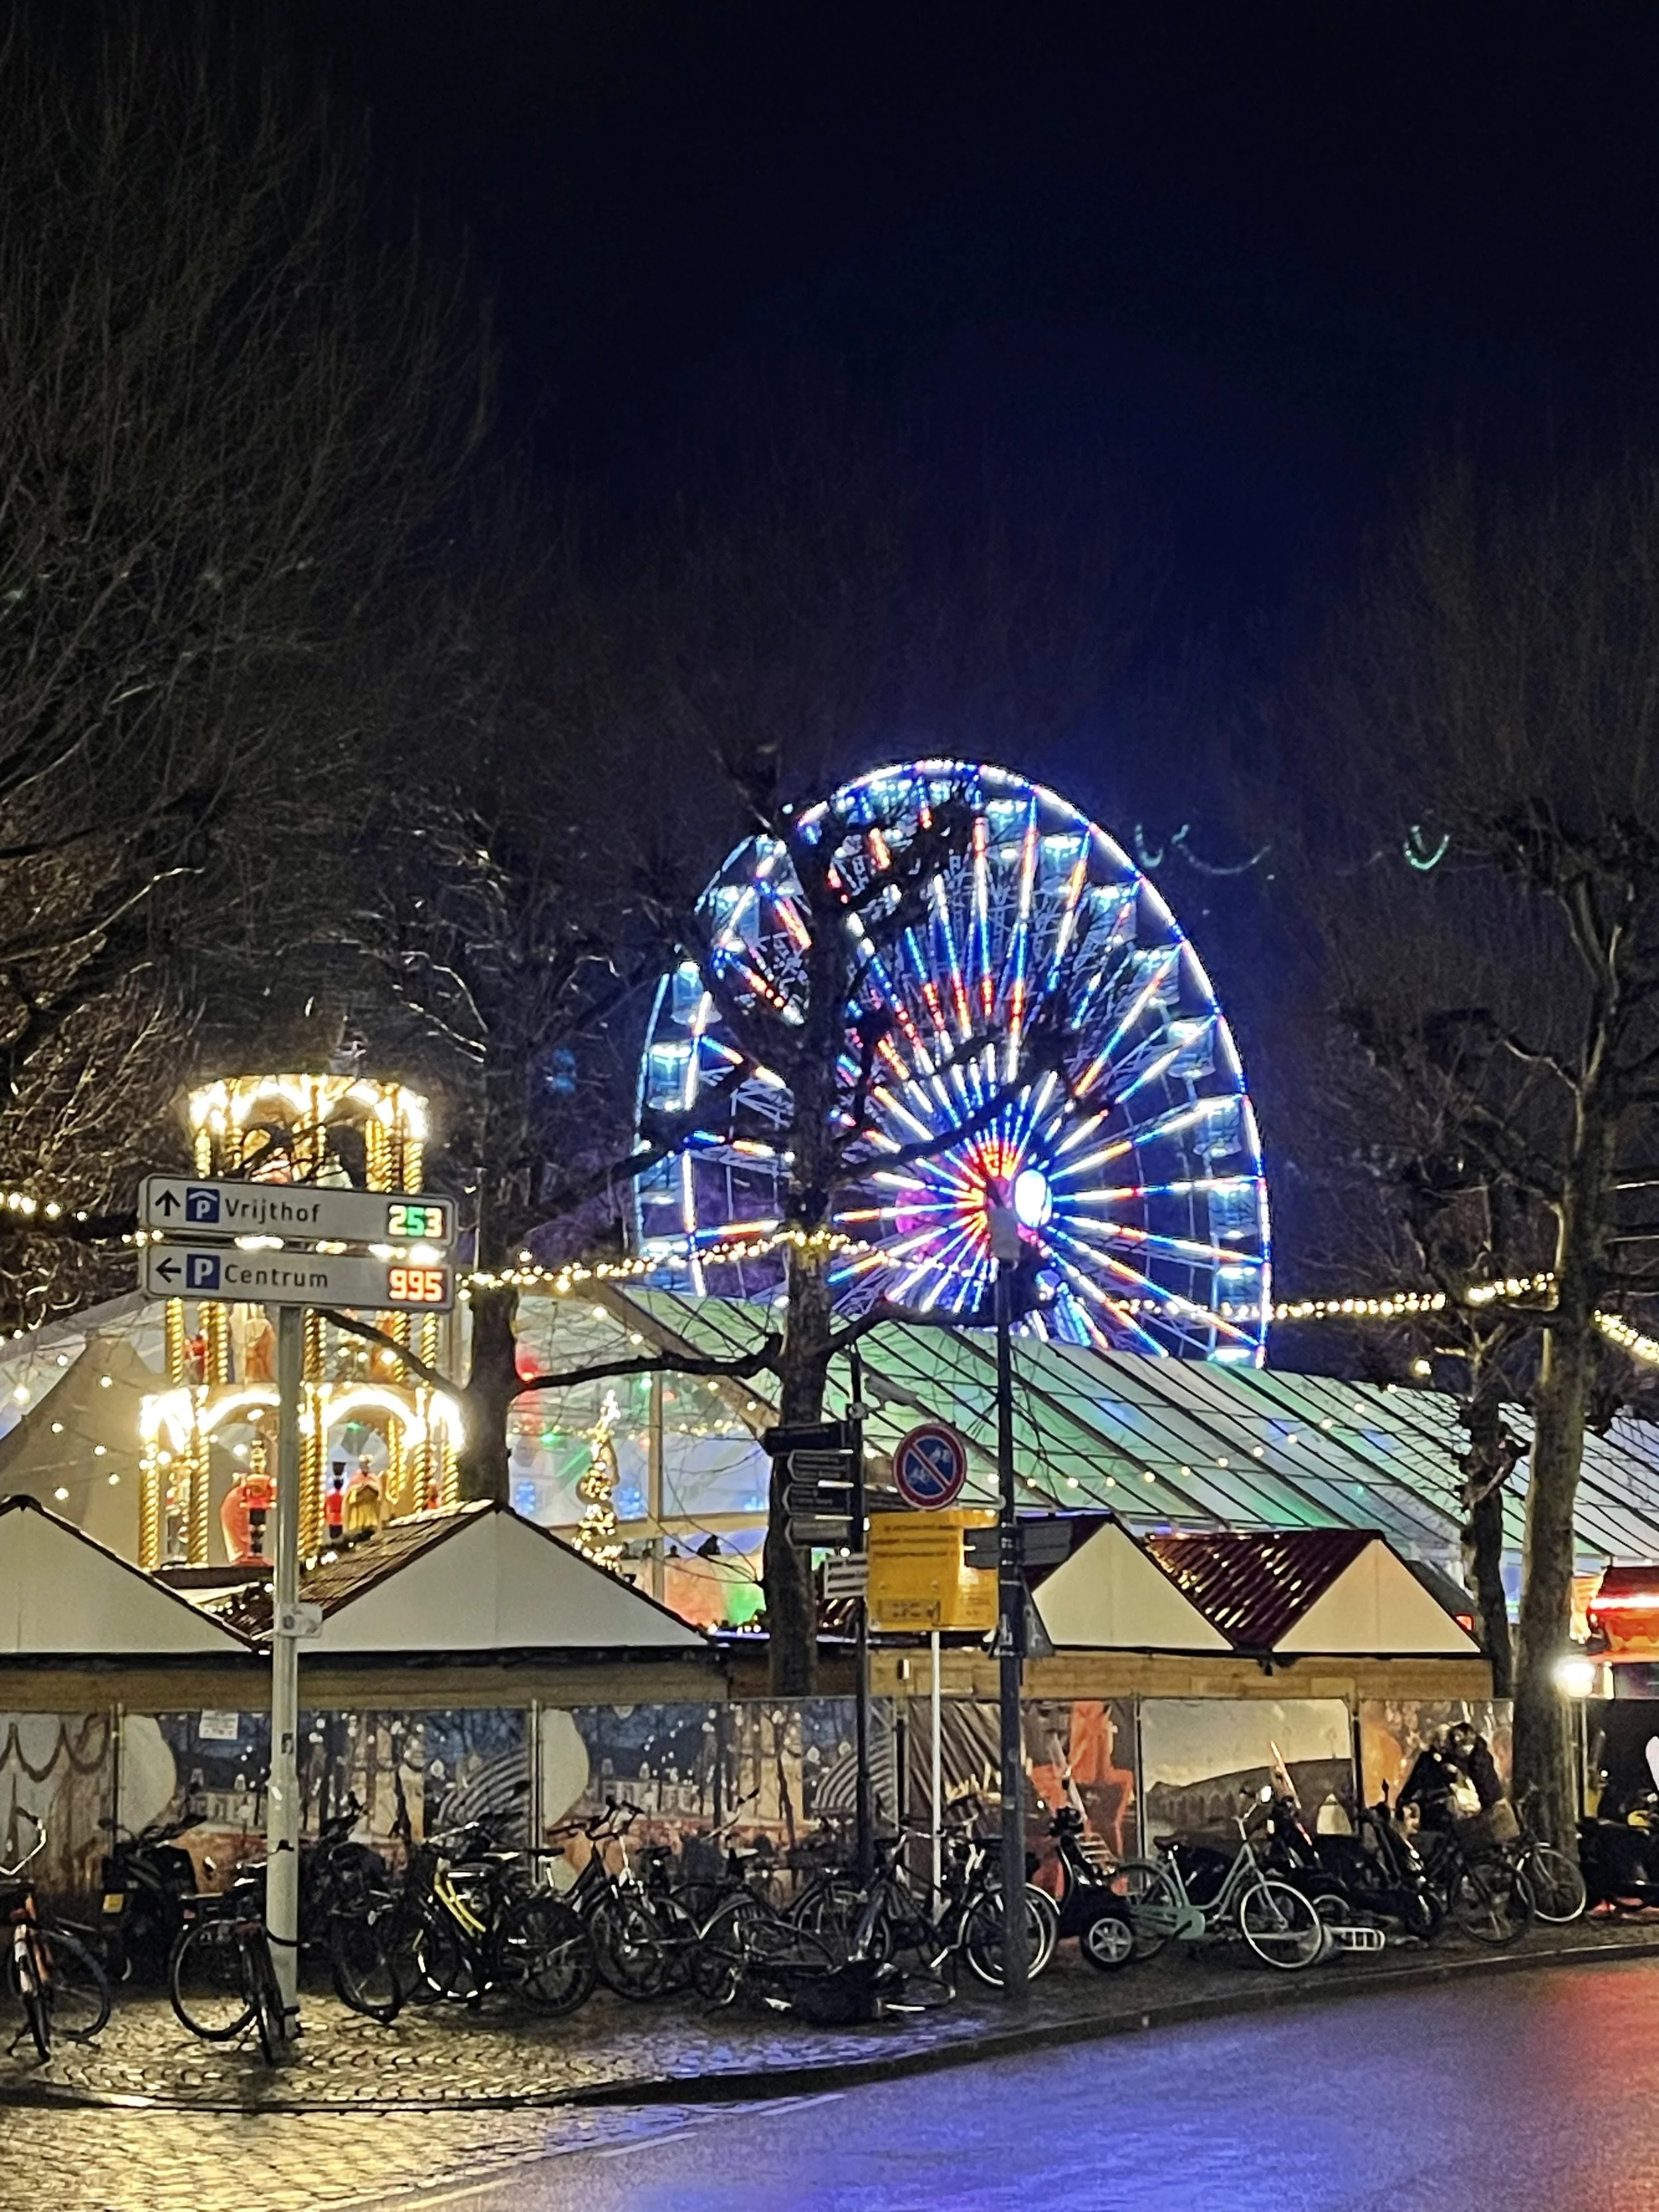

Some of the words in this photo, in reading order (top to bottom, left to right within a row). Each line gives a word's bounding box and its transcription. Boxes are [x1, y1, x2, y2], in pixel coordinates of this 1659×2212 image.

[224, 1198, 321, 1224] Vrijthof
[388, 1205, 443, 1238] 253
[194, 1259, 212, 1285] P
[224, 1264, 328, 1288] Centrum
[389, 1269, 443, 1302] 995
